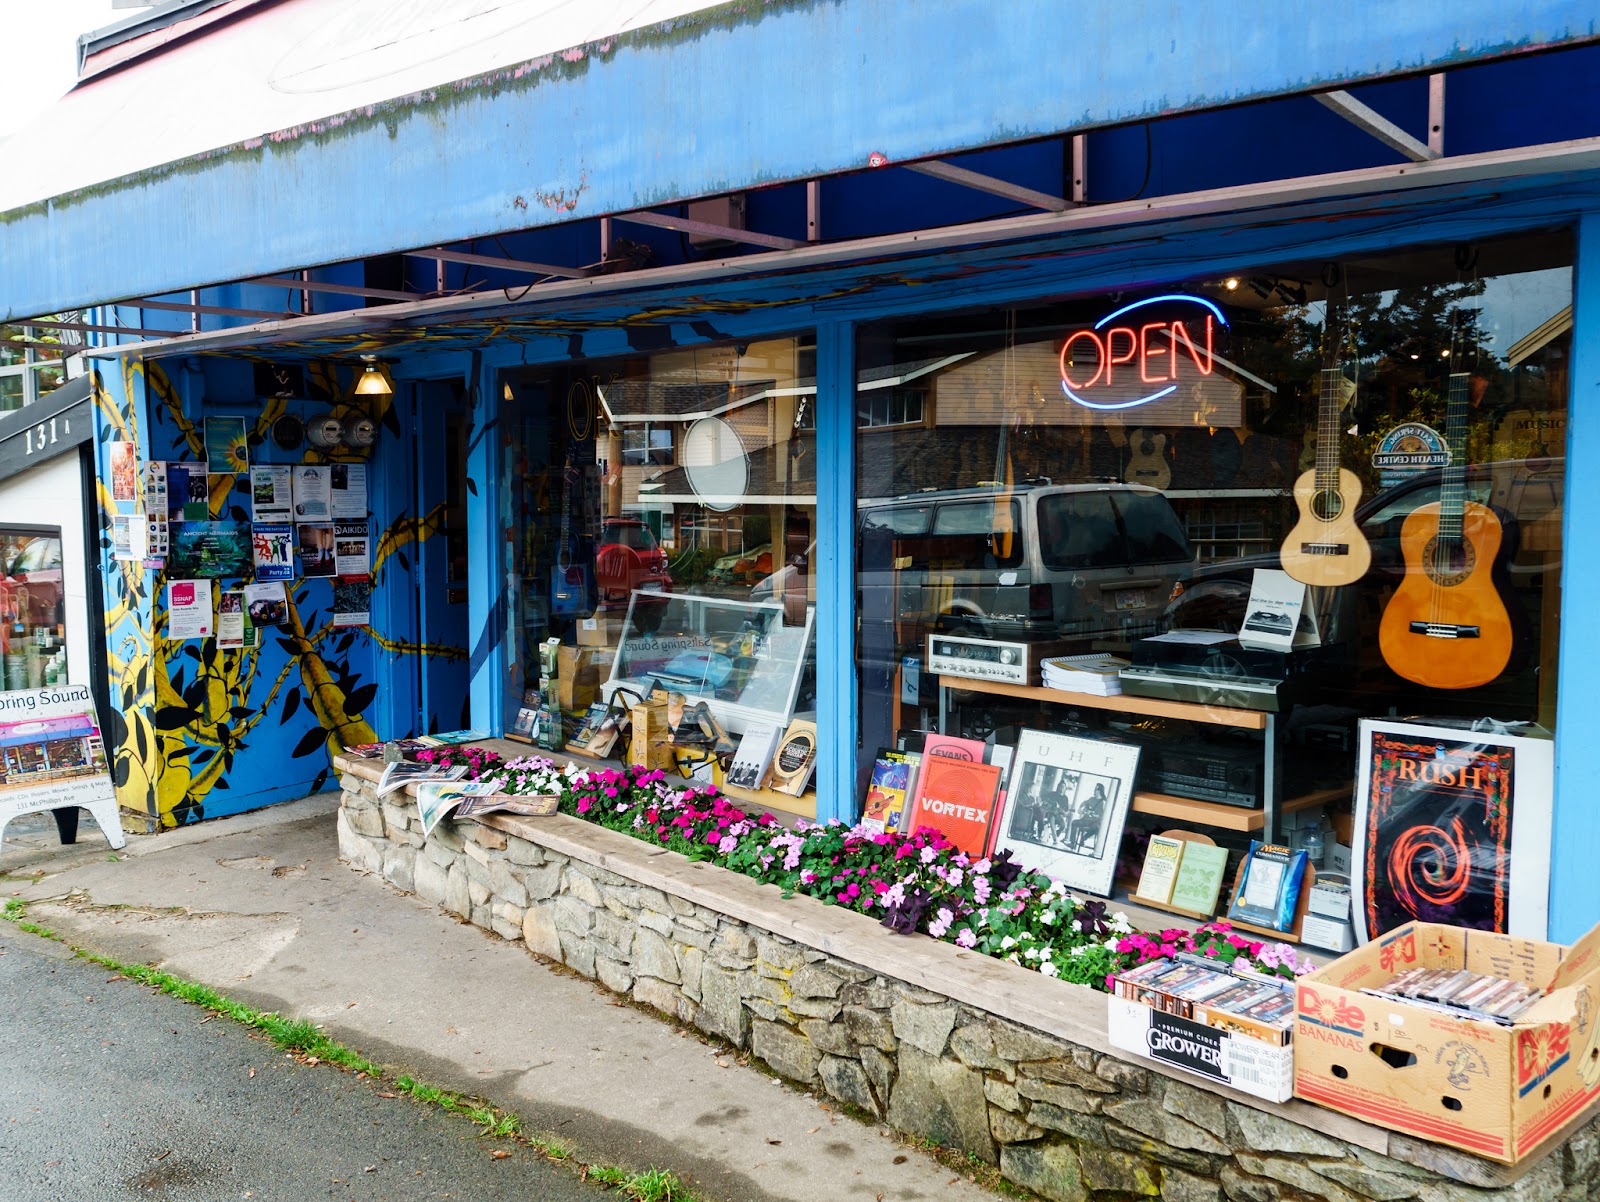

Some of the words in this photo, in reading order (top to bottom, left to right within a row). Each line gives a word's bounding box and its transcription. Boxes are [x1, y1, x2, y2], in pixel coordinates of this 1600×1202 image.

[1060, 314, 1214, 389] OPEN
[25, 417, 58, 455] 131
[64, 419, 71, 435] A
[342, 526, 368, 534] AIKIDO
[39, 687, 89, 705] Sound
[935, 749, 967, 760] EVANS
[1398, 759, 1482, 789] RUSH
[30, 798, 62, 808] McPhillips
[922, 798, 988, 823] VORTEX
[1298, 986, 1366, 1030] Dole
[1147, 1028, 1223, 1068] GROWER
[1162, 1025, 1194, 1038] PREMIUM
[1196, 1034, 1219, 1046] CIDER
[1228, 1040, 1260, 1055] GROWERS
[1299, 1023, 1363, 1053] BANANAS
[1518, 1107, 1546, 1137] PREMIUM
